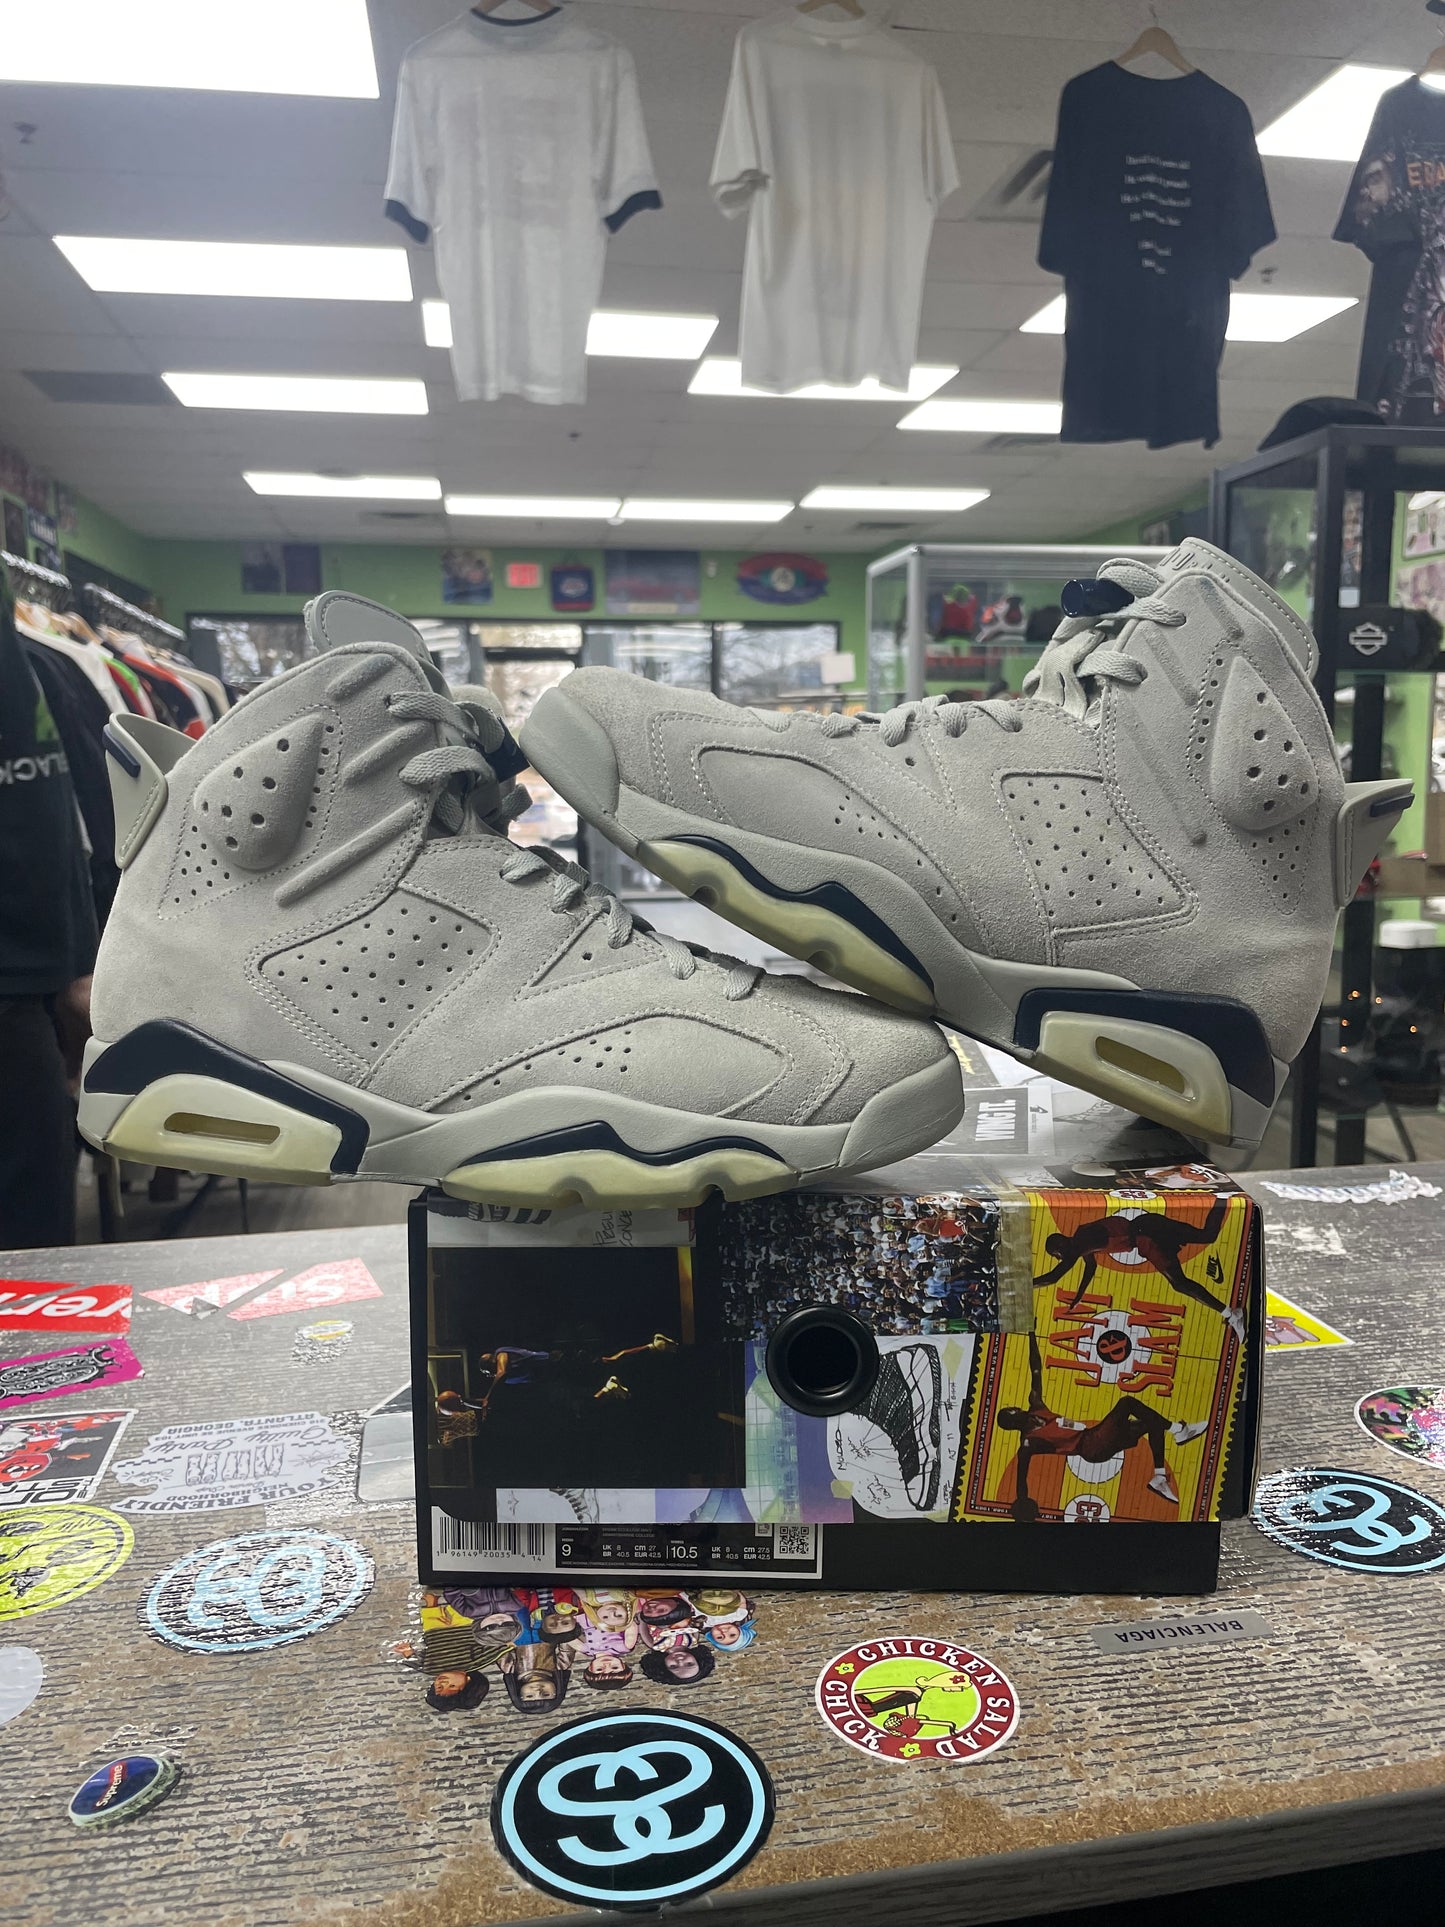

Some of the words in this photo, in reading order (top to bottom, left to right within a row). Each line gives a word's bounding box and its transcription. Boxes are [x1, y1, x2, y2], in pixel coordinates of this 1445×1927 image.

[975, 1112, 1016, 1141] WING
[1205, 1254, 1219, 1279] NIKE
[1045, 1287, 1112, 1387] JAM
[1117, 1298, 1186, 1397] SLAM
[168, 1421, 234, 1435] GEORGIA
[149, 1437, 237, 1453] Party
[166, 1481, 288, 1501] NEIGHBORHOOD
[259, 1477, 335, 1500] YOUR
[116, 1494, 251, 1511] FRIENDLY
[561, 1544, 572, 1558] 9
[670, 1546, 698, 1559] 10.5
[1116, 1619, 1243, 1644] BALENCIAGA
[857, 1641, 1002, 1688] CHICKEN
[934, 1697, 1014, 1757] SALAD
[825, 1679, 887, 1751] CHICK
[95, 1763, 123, 1808] Supreme
